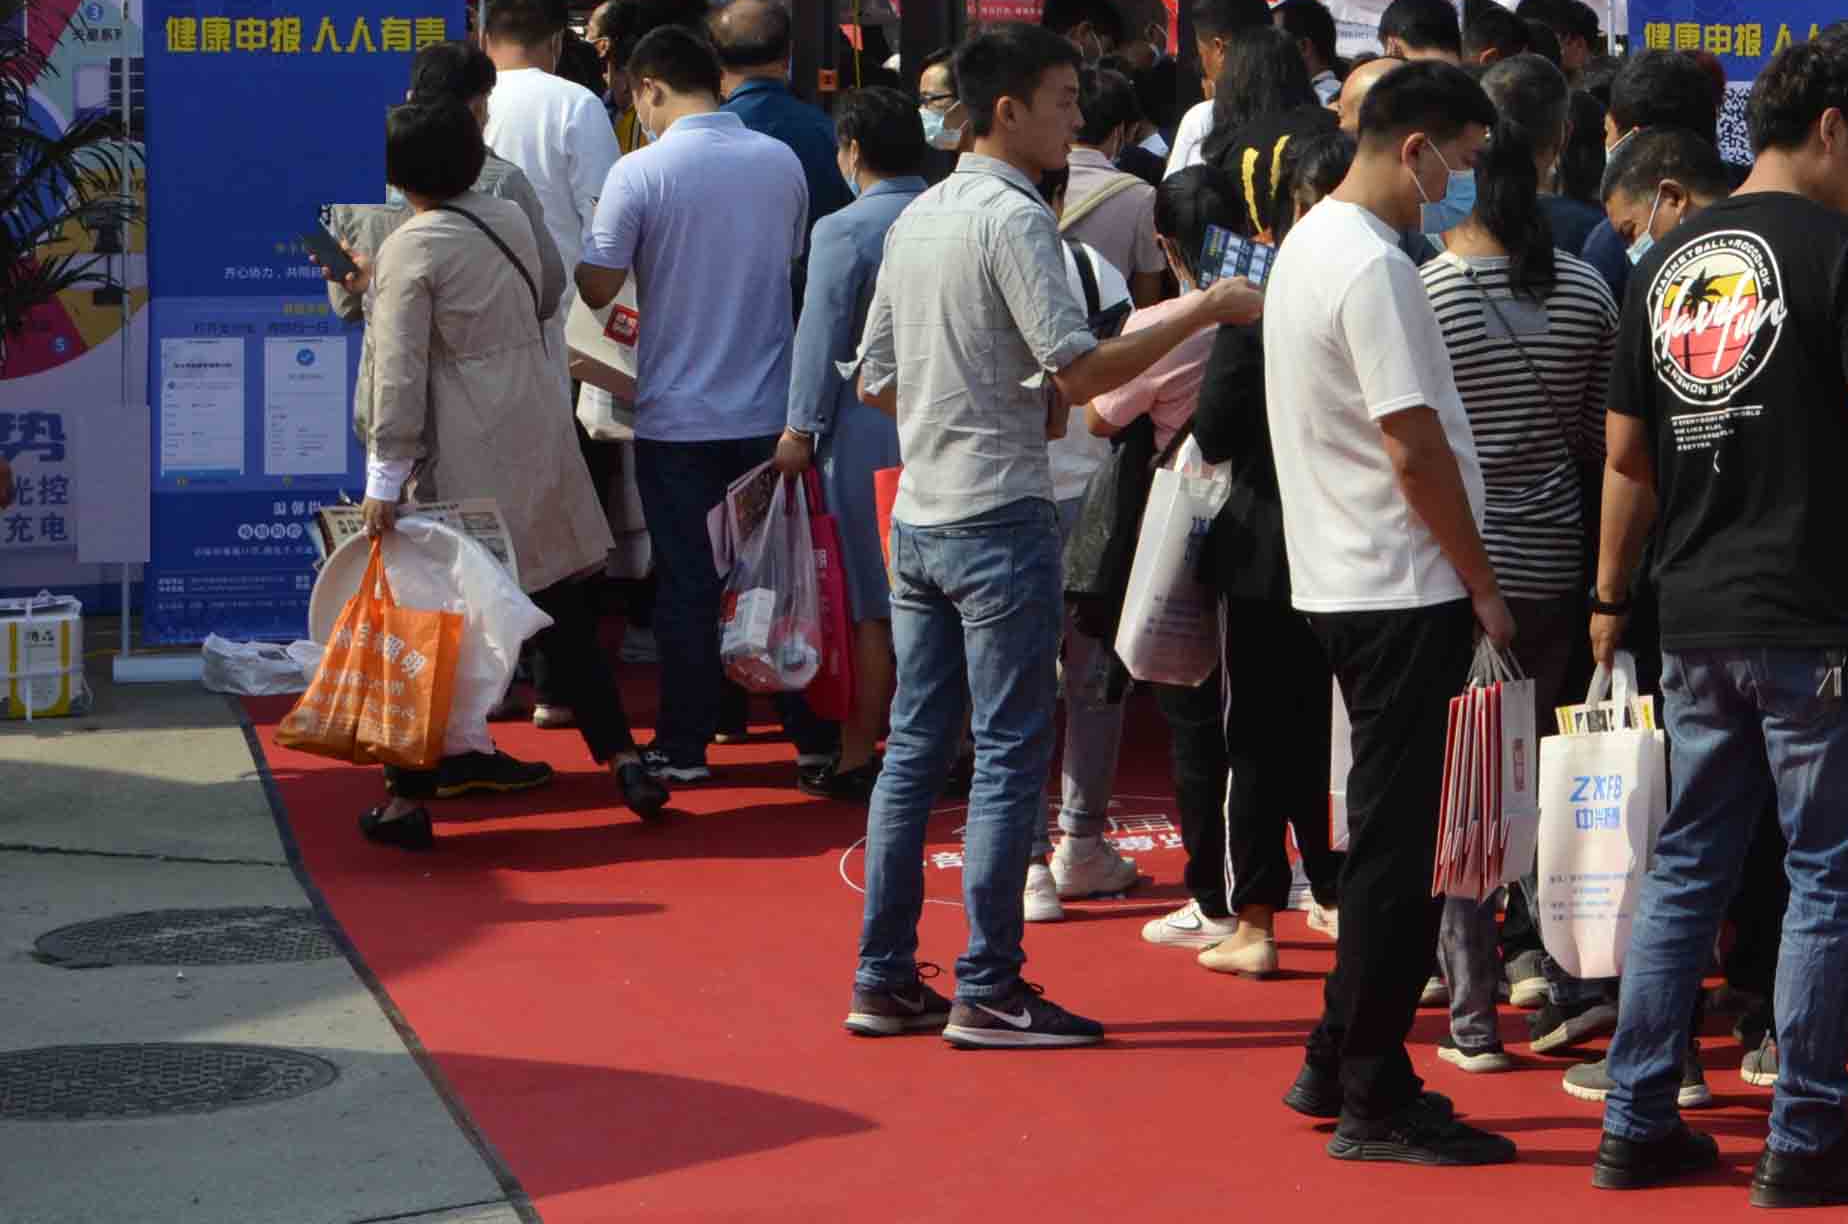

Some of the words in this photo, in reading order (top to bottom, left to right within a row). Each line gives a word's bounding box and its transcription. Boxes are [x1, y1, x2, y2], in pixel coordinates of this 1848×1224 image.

[165, 15, 302, 54] 健康申报
[311, 15, 447, 54] 人人有责
[1643, 22, 1762, 57] 健康申报
[4, 514, 69, 543] 充电
